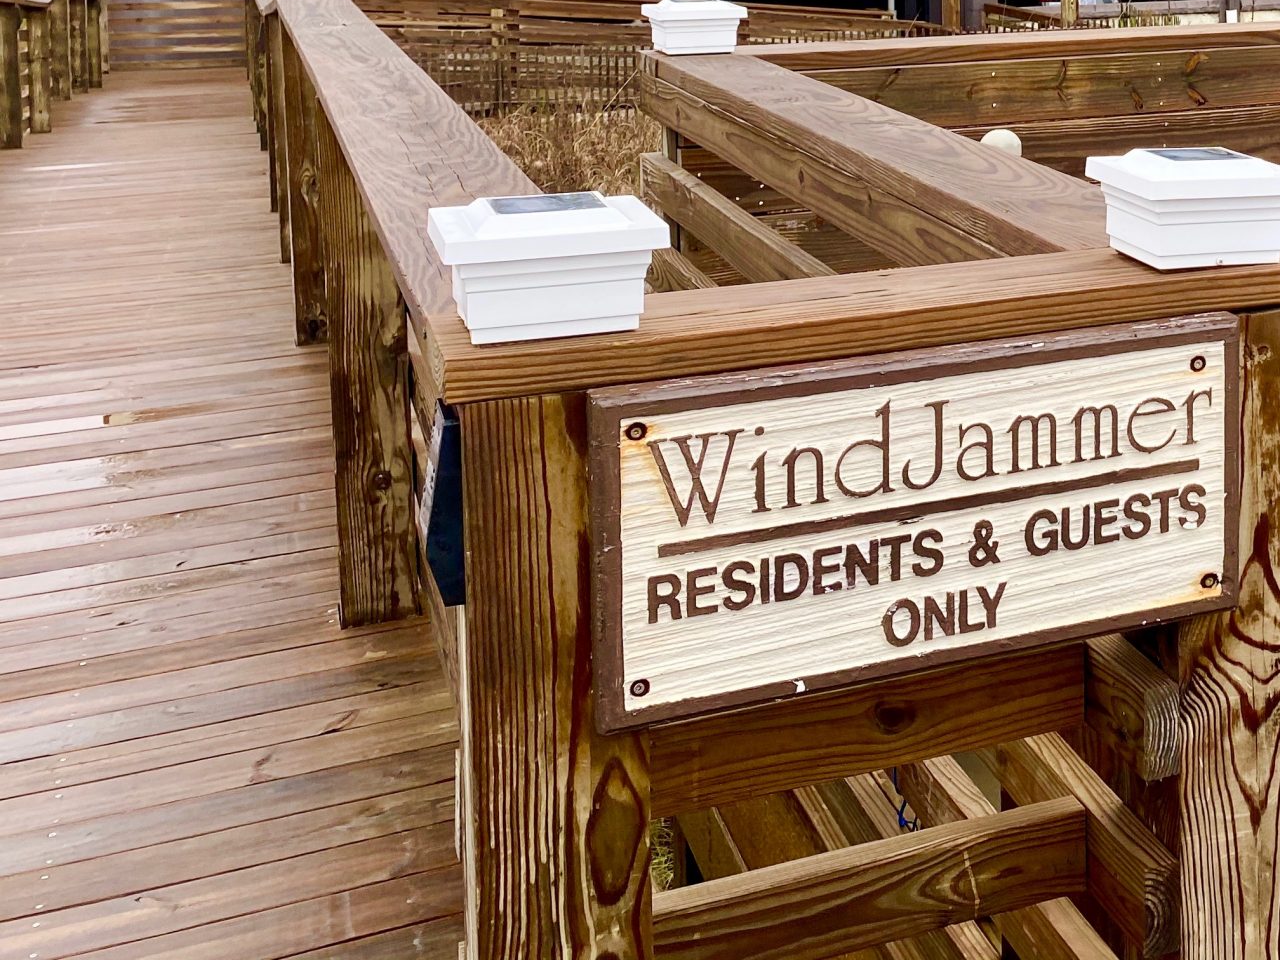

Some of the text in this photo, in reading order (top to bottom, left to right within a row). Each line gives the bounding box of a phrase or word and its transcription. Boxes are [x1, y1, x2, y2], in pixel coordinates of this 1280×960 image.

[646, 387, 1213, 528] WindJammer
[647, 484, 1207, 625] RESIDENTS & GUESTS
[880, 582, 1008, 648] ONLY
